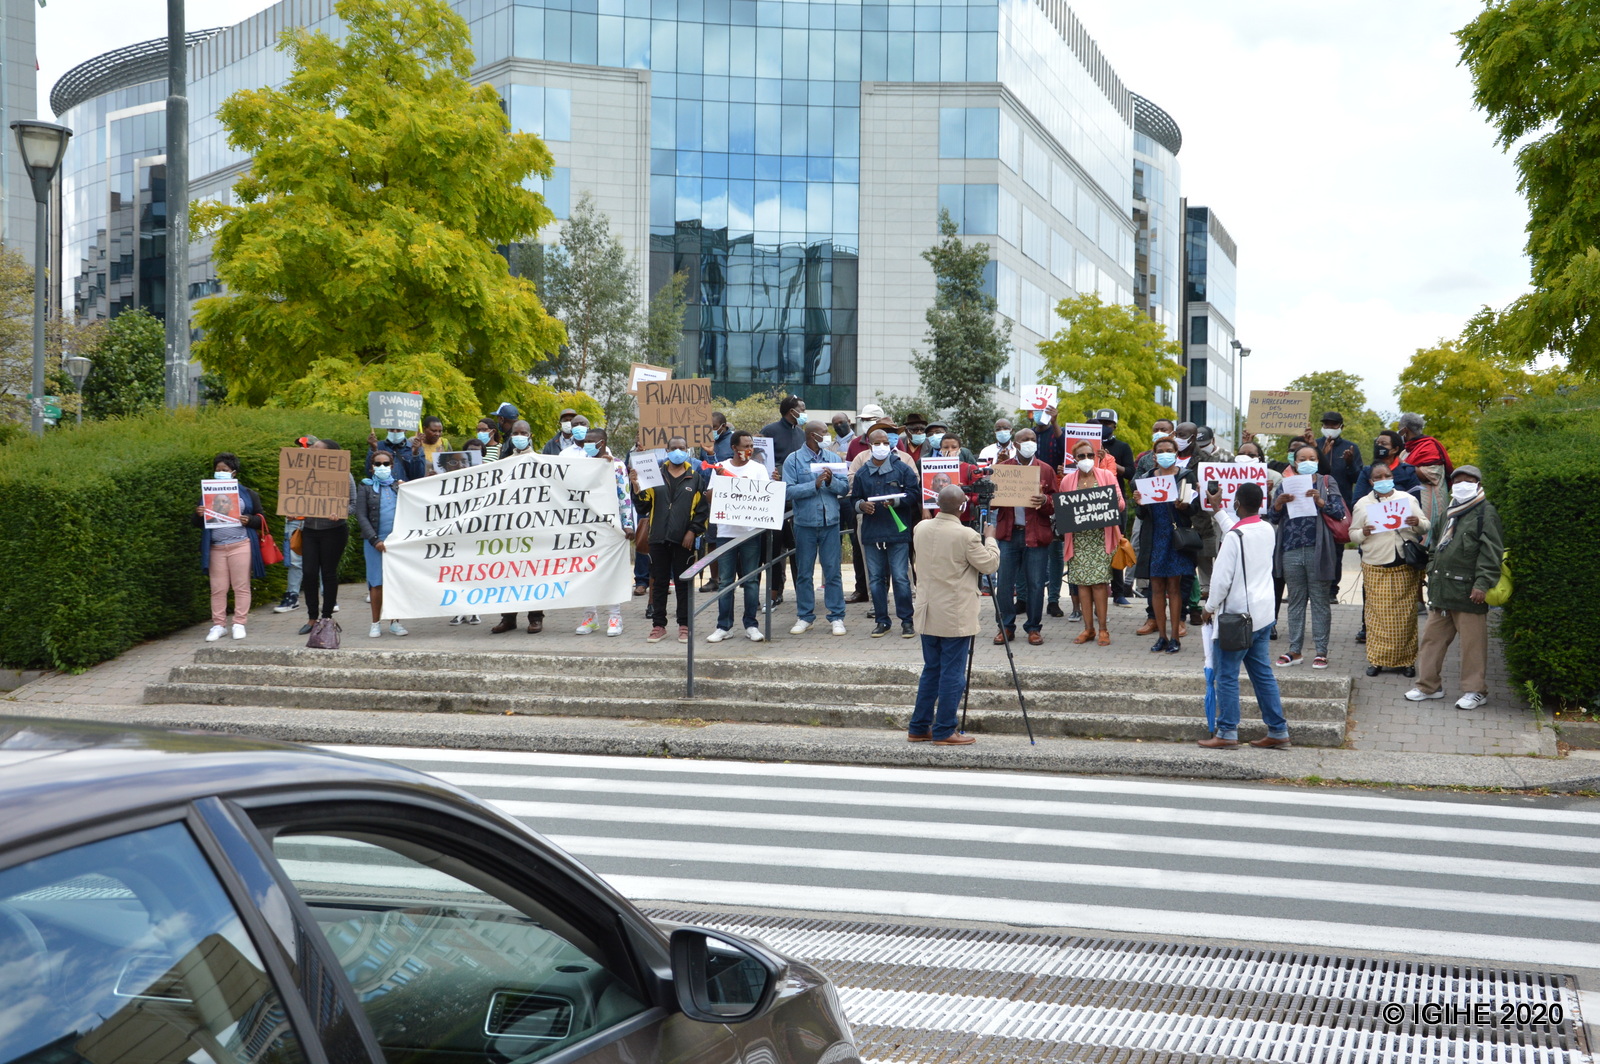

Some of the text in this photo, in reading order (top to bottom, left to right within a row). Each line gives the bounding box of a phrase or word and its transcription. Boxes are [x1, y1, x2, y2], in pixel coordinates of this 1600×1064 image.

[379, 394, 422, 410] RWANDA?
[646, 382, 711, 405] RWANDAN
[380, 418, 419, 428] EST MORT
[384, 408, 419, 420] LE DROIT
[656, 404, 707, 425] LIVES
[1260, 411, 1307, 420] OPPOSANTS
[1260, 421, 1307, 429] POLITIQUES
[642, 425, 713, 446] MATTER
[307, 468, 316, 481] A
[439, 461, 570, 496] LIBERATION
[1204, 466, 1267, 481] RWANDA
[286, 478, 349, 497] PEACEFUL
[1058, 487, 1113, 506] RWANDA?
[425, 485, 590, 522] IMMEDIATE ET
[1073, 502, 1109, 515] LE DROIT
[424, 530, 597, 560] DE TOUS LES
[437, 555, 599, 583] PRISONNIERS
